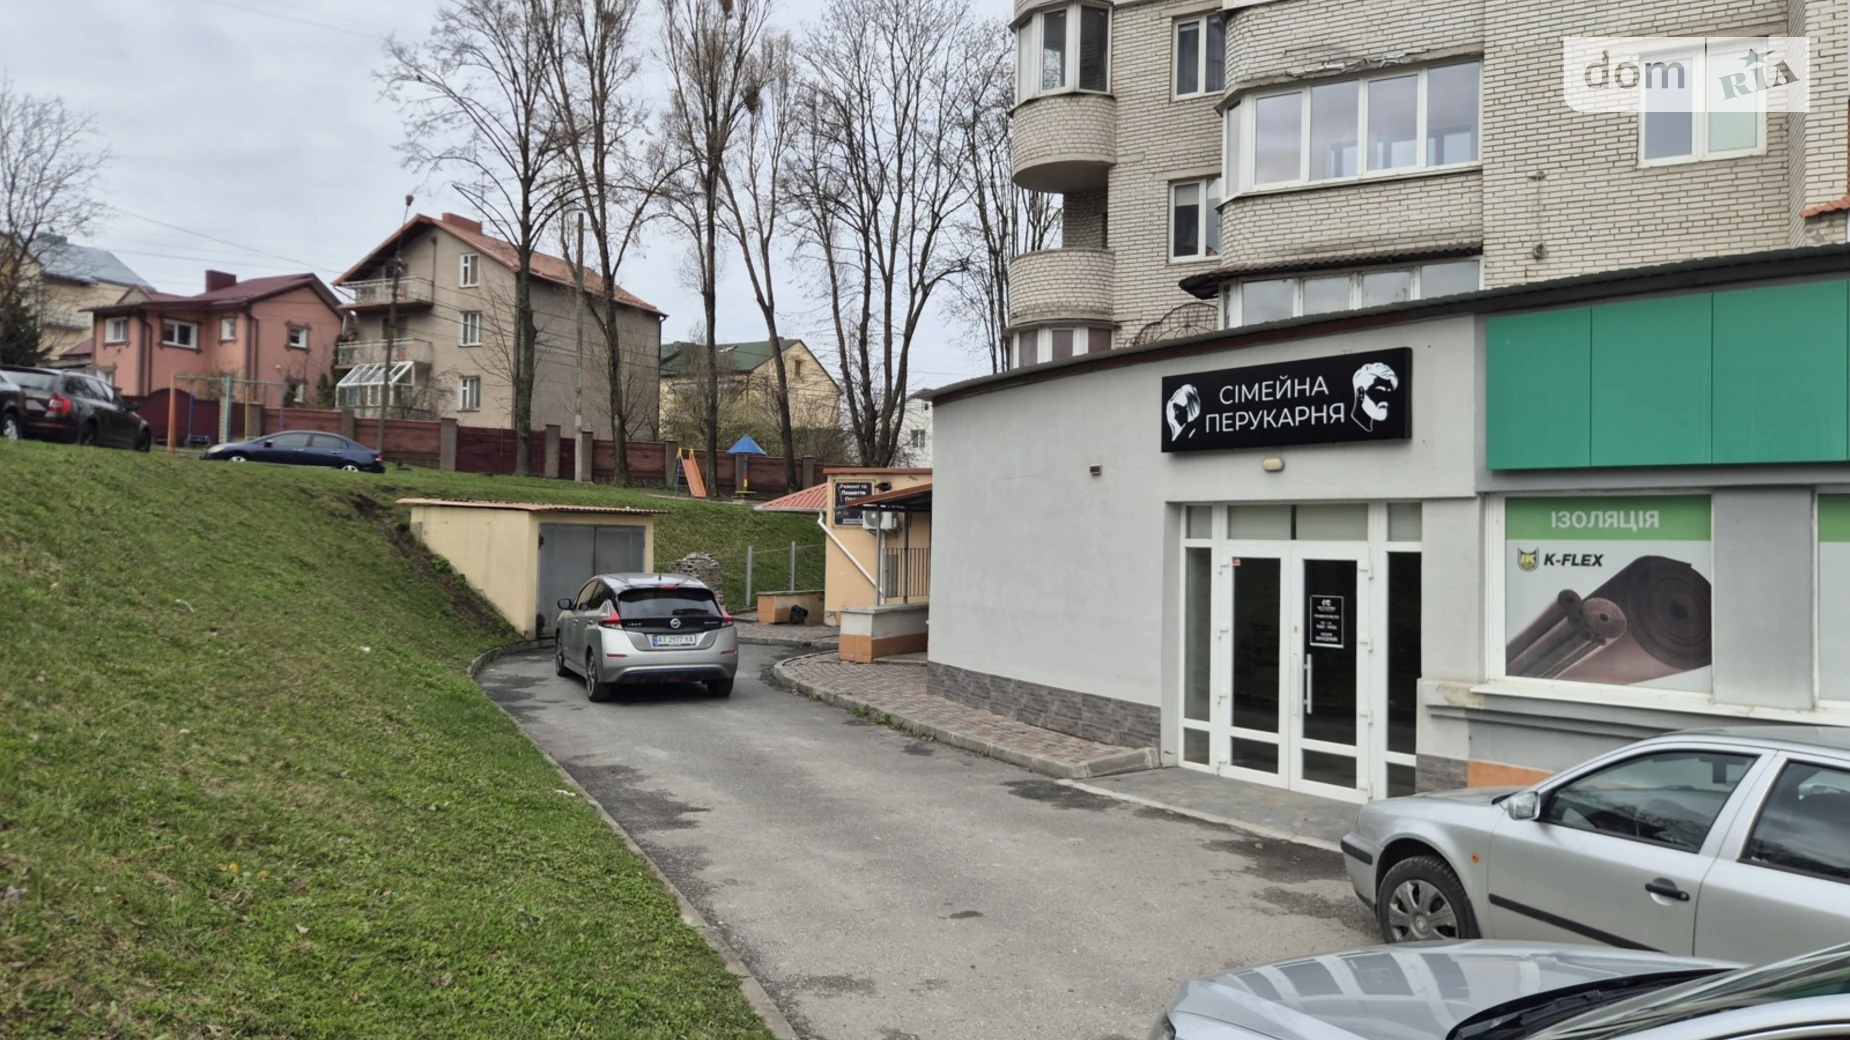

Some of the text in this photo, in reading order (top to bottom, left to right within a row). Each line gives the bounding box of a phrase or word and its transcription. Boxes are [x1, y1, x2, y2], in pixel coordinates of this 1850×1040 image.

[1219, 375, 1330, 405] СІМЕЙНА
[1205, 402, 1345, 433] ПЕРУКАРНЯ
[1551, 510, 1660, 531] ІЗОЛЯЦІЯ
[1544, 553, 1604, 567] K-FLEX
